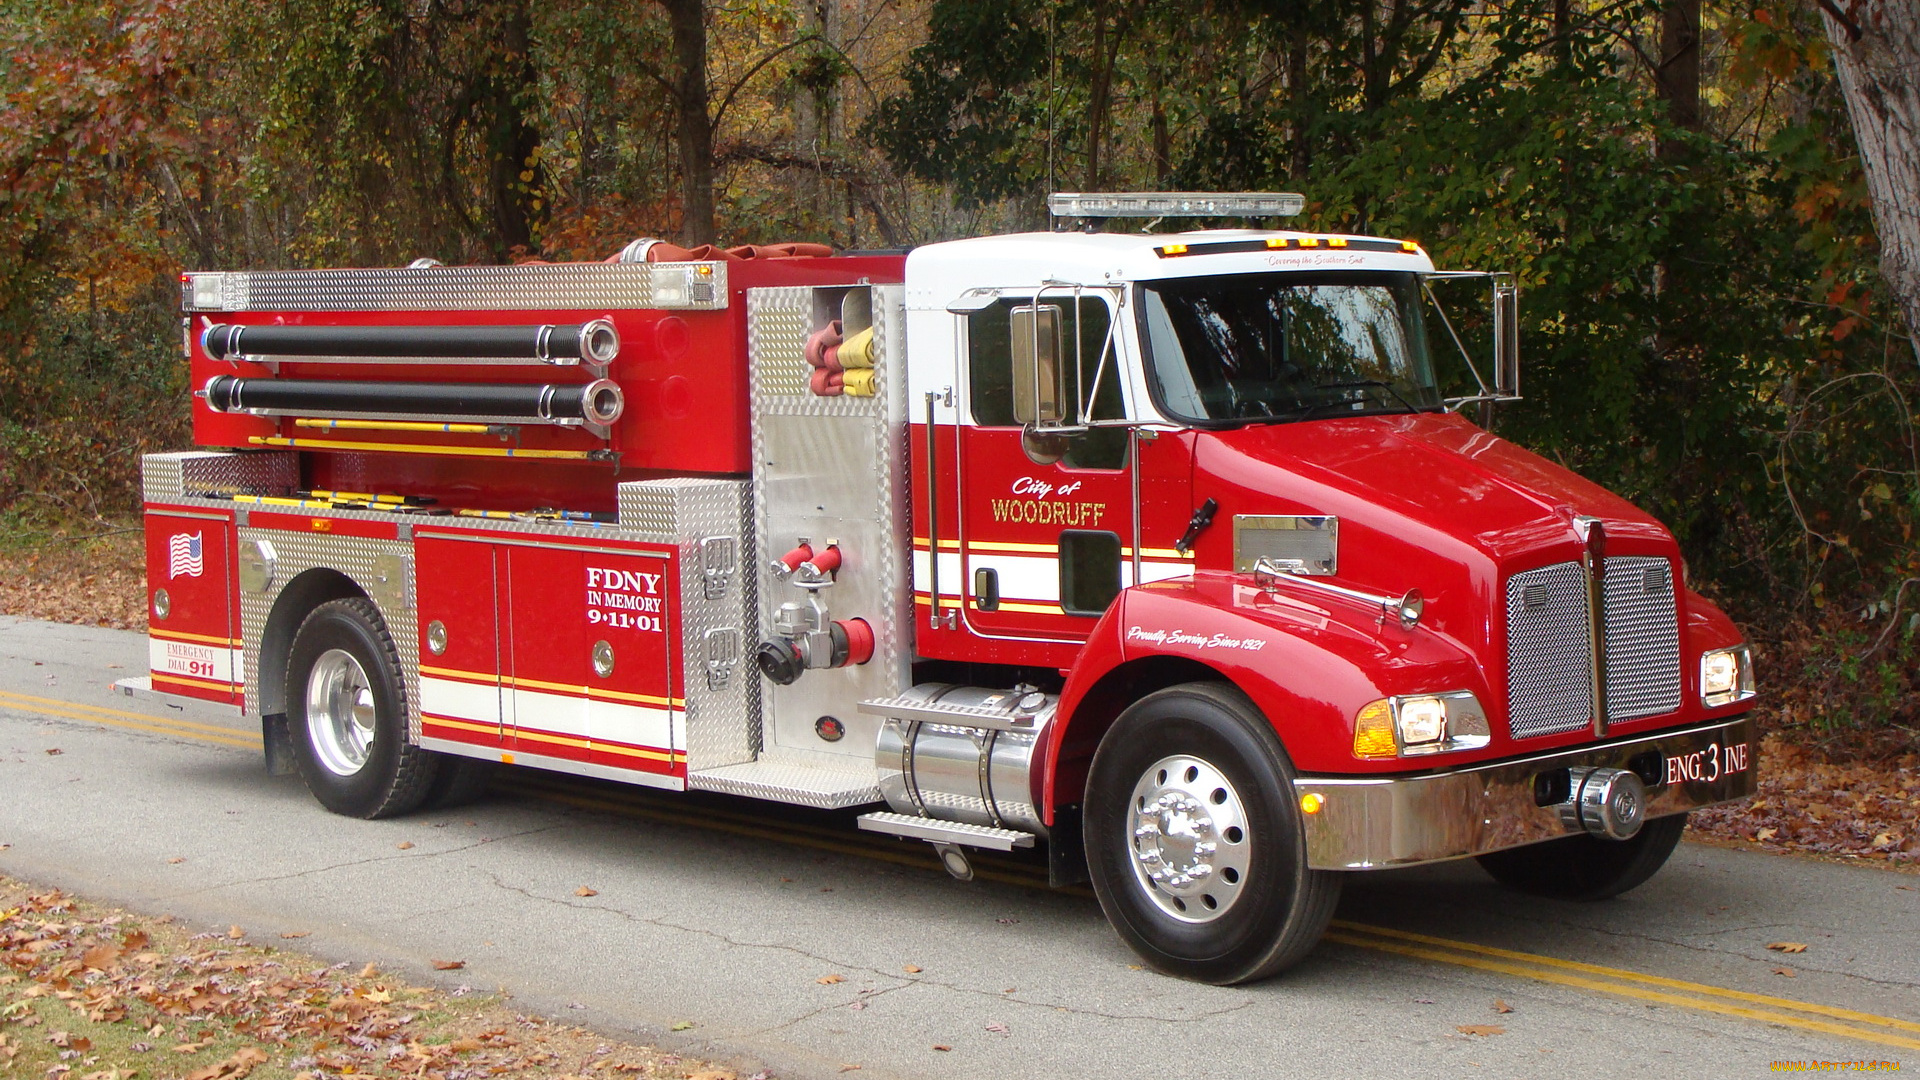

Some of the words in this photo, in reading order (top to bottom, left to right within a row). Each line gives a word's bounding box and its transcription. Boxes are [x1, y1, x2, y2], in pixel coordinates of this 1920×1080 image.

[1301, 256, 1312, 264] the
[1314, 254, 1346, 265] Southern
[1012, 477, 1053, 499] City
[1057, 480, 1081, 496] of
[991, 499, 1106, 526] WOODRUFF
[587, 567, 661, 594] FDNY
[587, 590, 602, 606] IN
[604, 592, 662, 613] MEMORY
[1127, 626, 1167, 645] Proudly
[1166, 630, 1208, 649] Serving
[1207, 633, 1241, 648] Since
[1240, 639, 1267, 651] 1921
[167, 643, 215, 660] EMERGENCY
[168, 659, 187, 671] DIAL
[189, 660, 214, 677] 911
